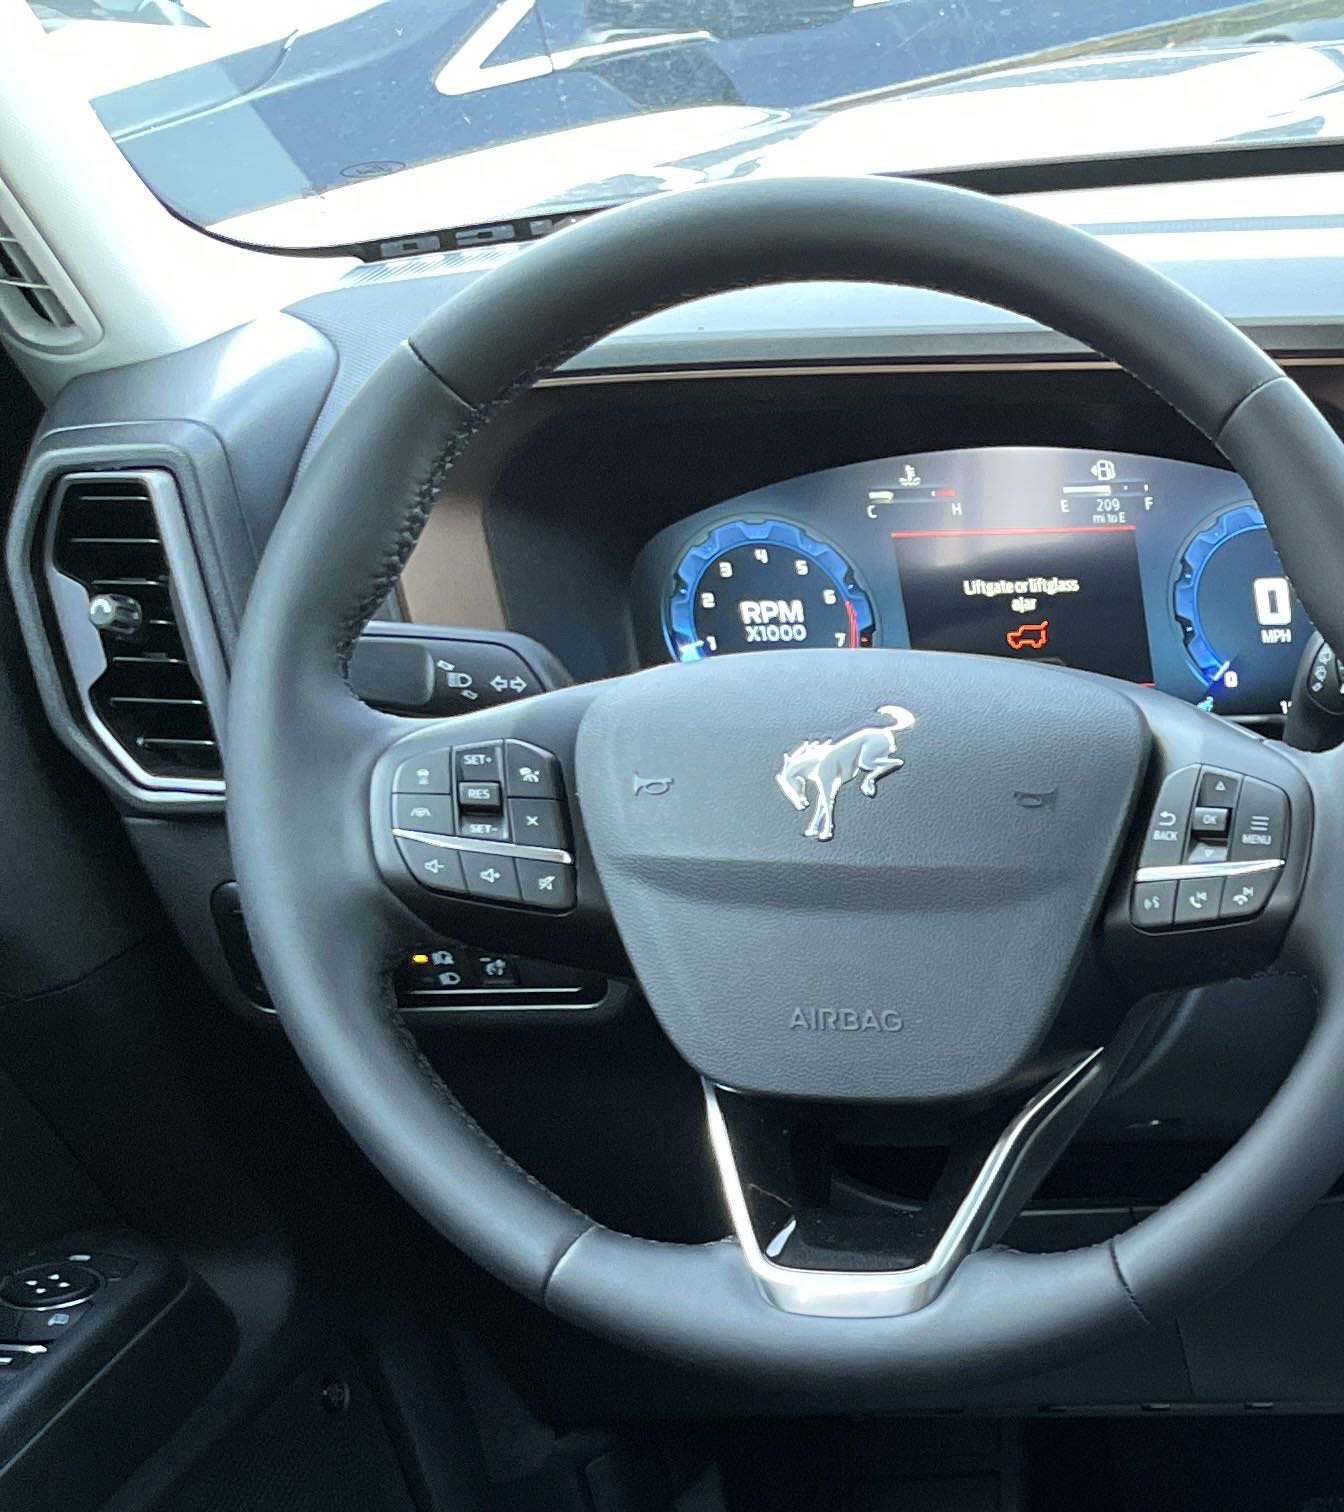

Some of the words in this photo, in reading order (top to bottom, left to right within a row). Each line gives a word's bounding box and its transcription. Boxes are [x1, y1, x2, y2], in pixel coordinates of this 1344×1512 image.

[1096, 498, 1121, 512] 209
[963, 578, 1015, 597] Liftgate
[1015, 582, 1029, 594] or
[1029, 577, 1080, 596] liftglass
[1011, 597, 1038, 613] ajar
[1253, 577, 1292, 625] 0
[739, 600, 805, 625] RPM
[745, 625, 807, 642] X1000
[1261, 629, 1292, 643] MPH
[468, 789, 490, 799] RES
[1203, 814, 1217, 825] OK
[1152, 830, 1178, 841] BACK
[1241, 834, 1272, 845] MENU
[790, 1007, 904, 1032] AIRBAG
